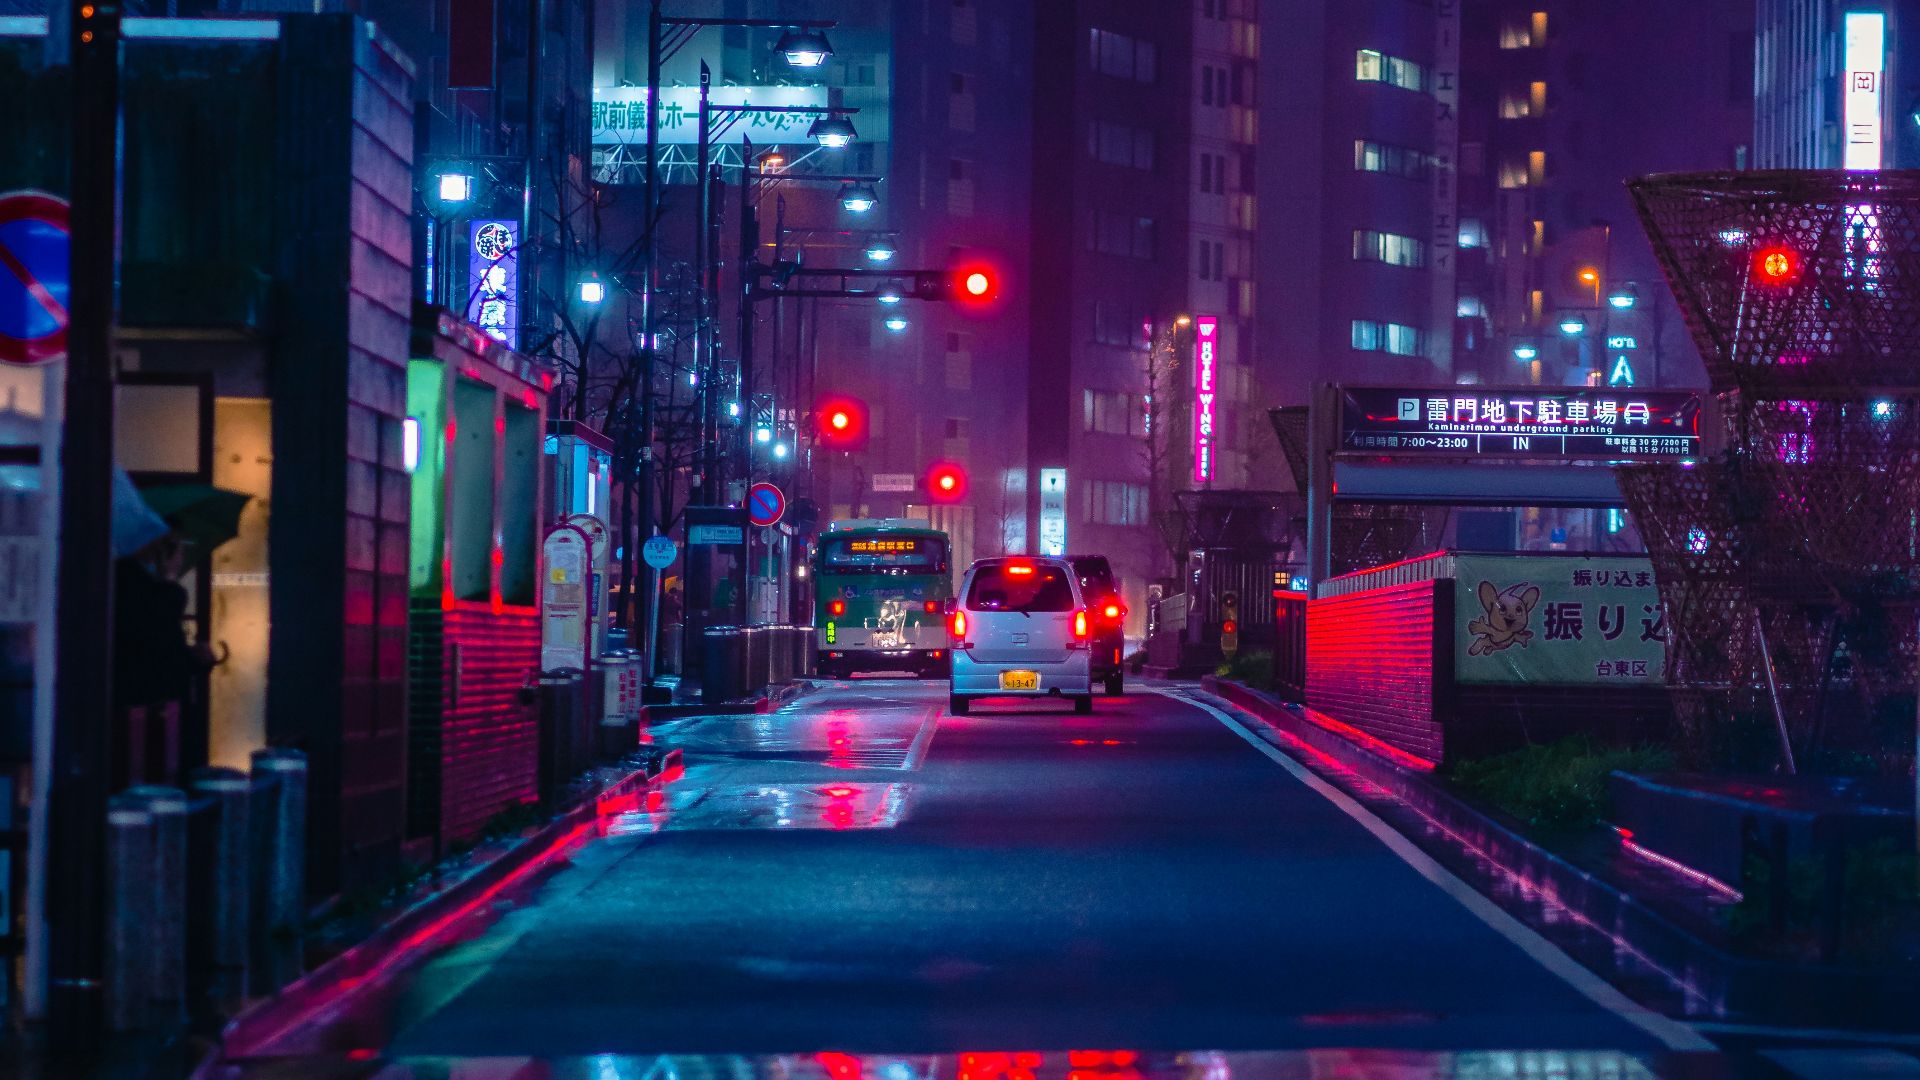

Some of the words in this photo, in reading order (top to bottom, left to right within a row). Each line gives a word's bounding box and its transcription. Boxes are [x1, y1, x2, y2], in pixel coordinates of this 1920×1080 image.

[592, 101, 718, 130] 駅前儀ホール
[1201, 341, 1213, 391] HOTEL
[1609, 355, 1635, 386] A
[1199, 393, 1214, 435] WING
[1426, 398, 1618, 425] 雷門地下駐車場
[1354, 436, 1398, 447] 利用時間
[1428, 423, 1496, 432] Kaminarimon
[1500, 424, 1568, 433] underground
[1573, 425, 1613, 434] parking
[1513, 437, 1529, 450] IN
[1573, 569, 1651, 588] 振り込ま
[1543, 602, 1665, 642] 振り込
[1596, 660, 1648, 678] 台東区
